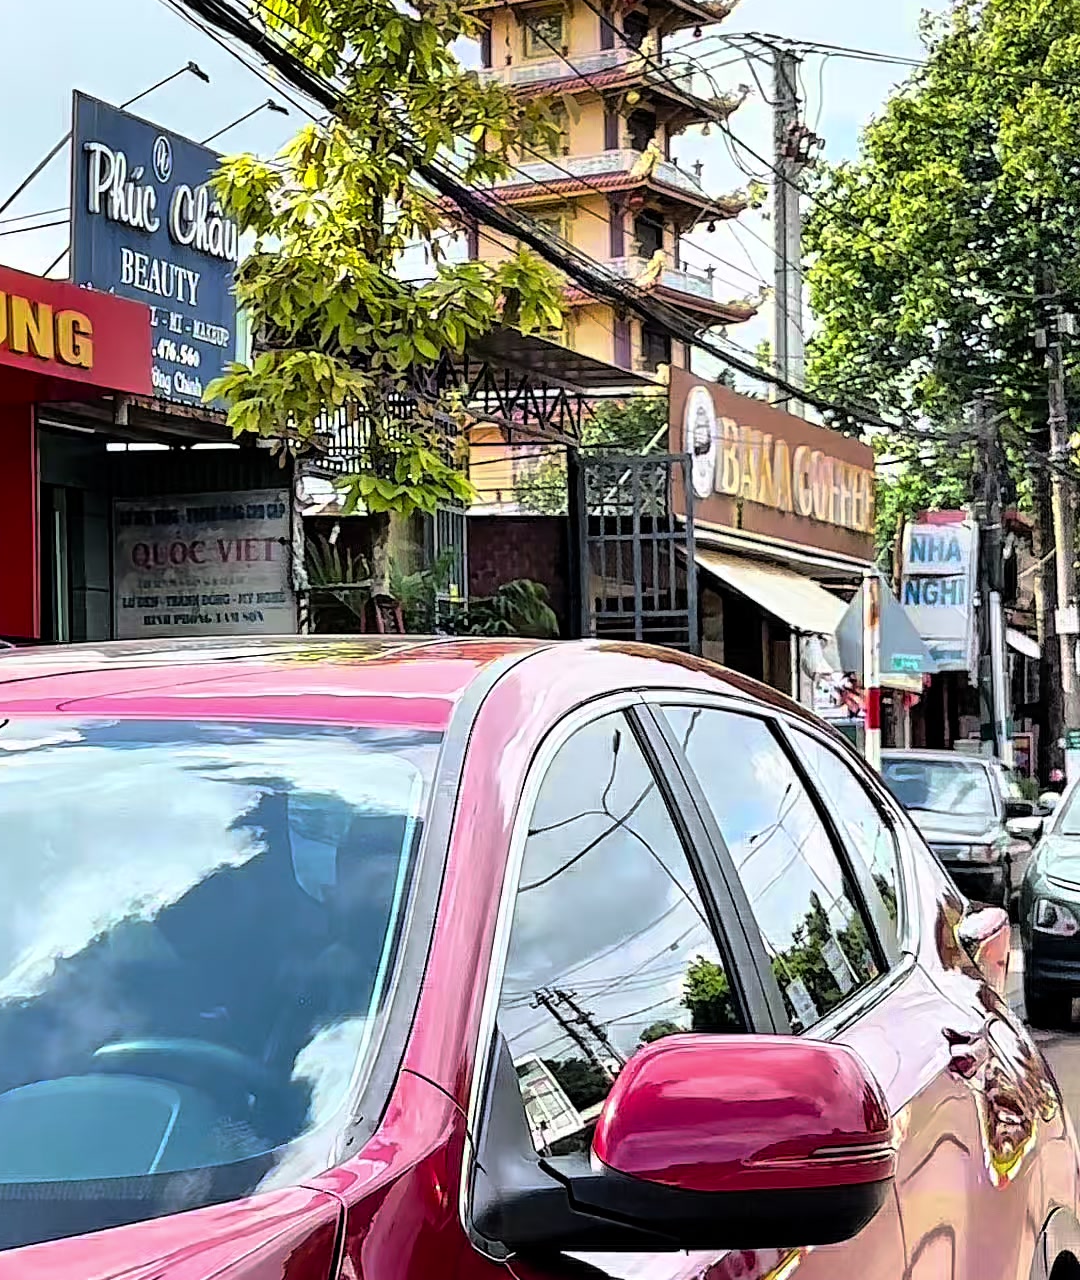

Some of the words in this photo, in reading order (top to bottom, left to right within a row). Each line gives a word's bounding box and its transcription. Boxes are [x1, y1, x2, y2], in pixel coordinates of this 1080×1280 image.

[84, 142, 160, 233] Phúc
[120, 247, 201, 307] BEAUTY
[151, 338, 201, 368] .476.560
